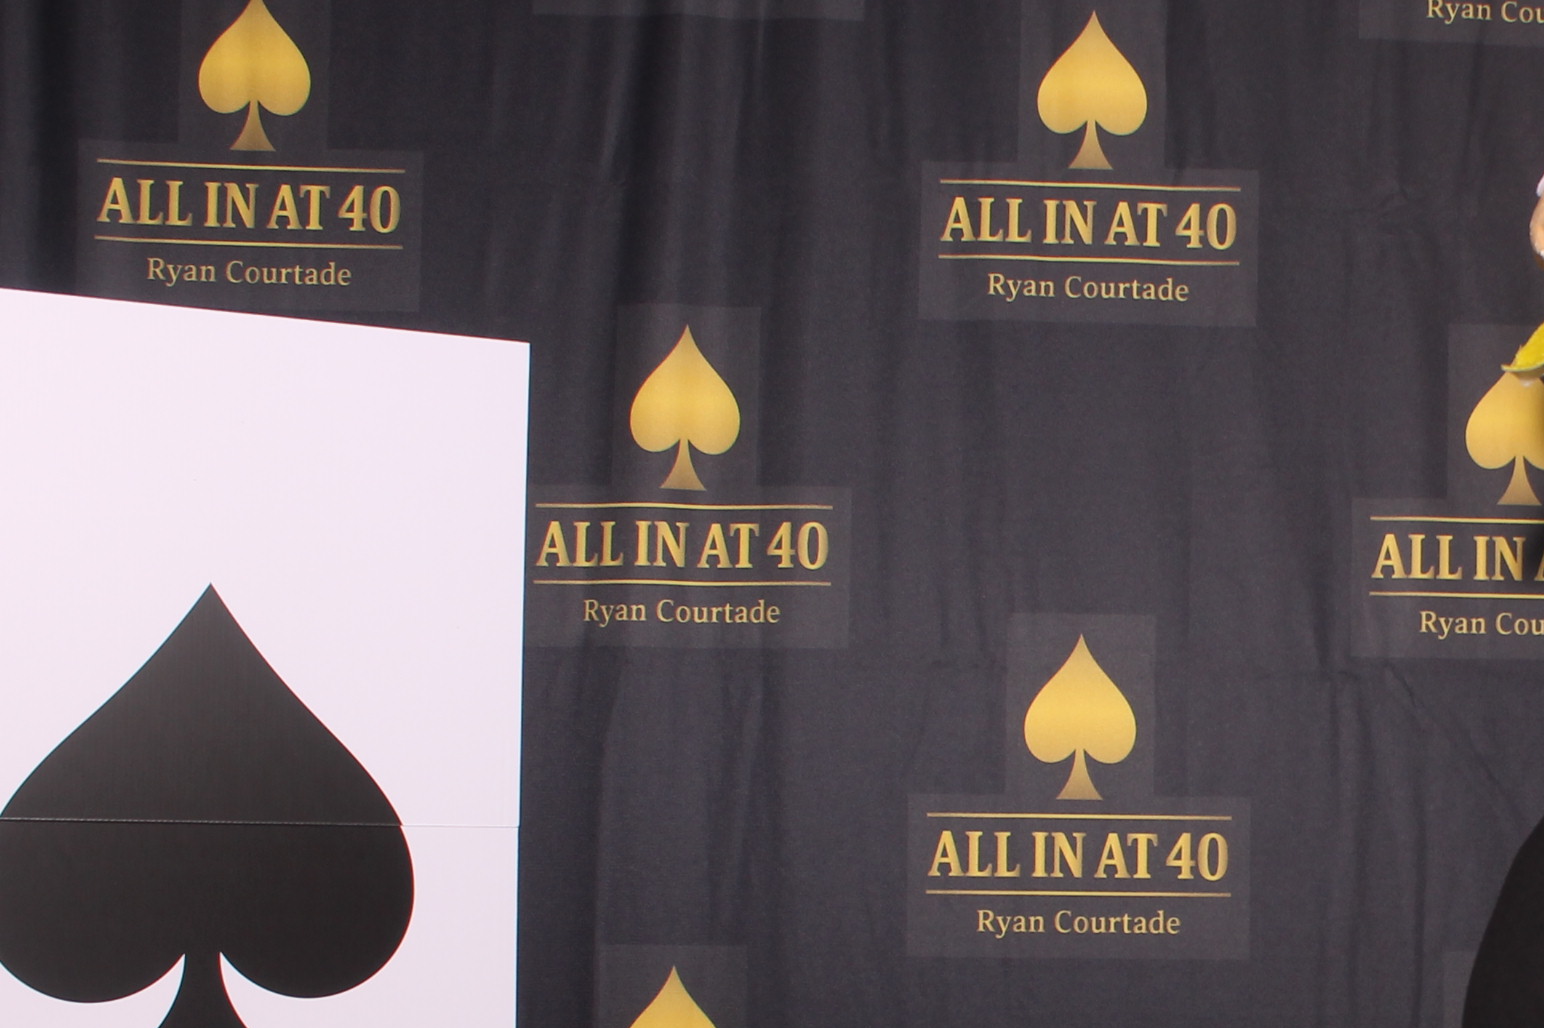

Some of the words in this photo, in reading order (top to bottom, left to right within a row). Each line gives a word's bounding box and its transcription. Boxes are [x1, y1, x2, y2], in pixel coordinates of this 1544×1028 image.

[1426, 0, 1492, 25] Ryan
[97, 176, 192, 226] ALL
[203, 181, 259, 229] IN
[266, 183, 330, 231] AT
[337, 184, 400, 234] 40
[940, 196, 1032, 243] ALL
[1042, 198, 1097, 245] IN
[1104, 200, 1168, 247] AT
[1175, 202, 1237, 250] 40
[146, 257, 216, 287] Ryan
[225, 259, 352, 286] Courtade
[987, 272, 1055, 302] Ryan
[1064, 275, 1190, 302] Courtade
[535, 520, 623, 567] ALL
[634, 519, 689, 568] IN
[696, 522, 759, 569] AT
[767, 521, 829, 570] 40
[1370, 532, 1463, 580] ALL
[1472, 534, 1526, 581] IN
[583, 599, 647, 628] Ryan
[655, 598, 781, 624] Courtade
[1419, 610, 1487, 640] Ryan
[927, 830, 1020, 878] ALL
[1031, 831, 1086, 878] IN
[1094, 832, 1158, 879] AT
[1165, 832, 1228, 882] 40
[976, 909, 1045, 939] Ryan
[1054, 909, 1181, 935] Courtade
